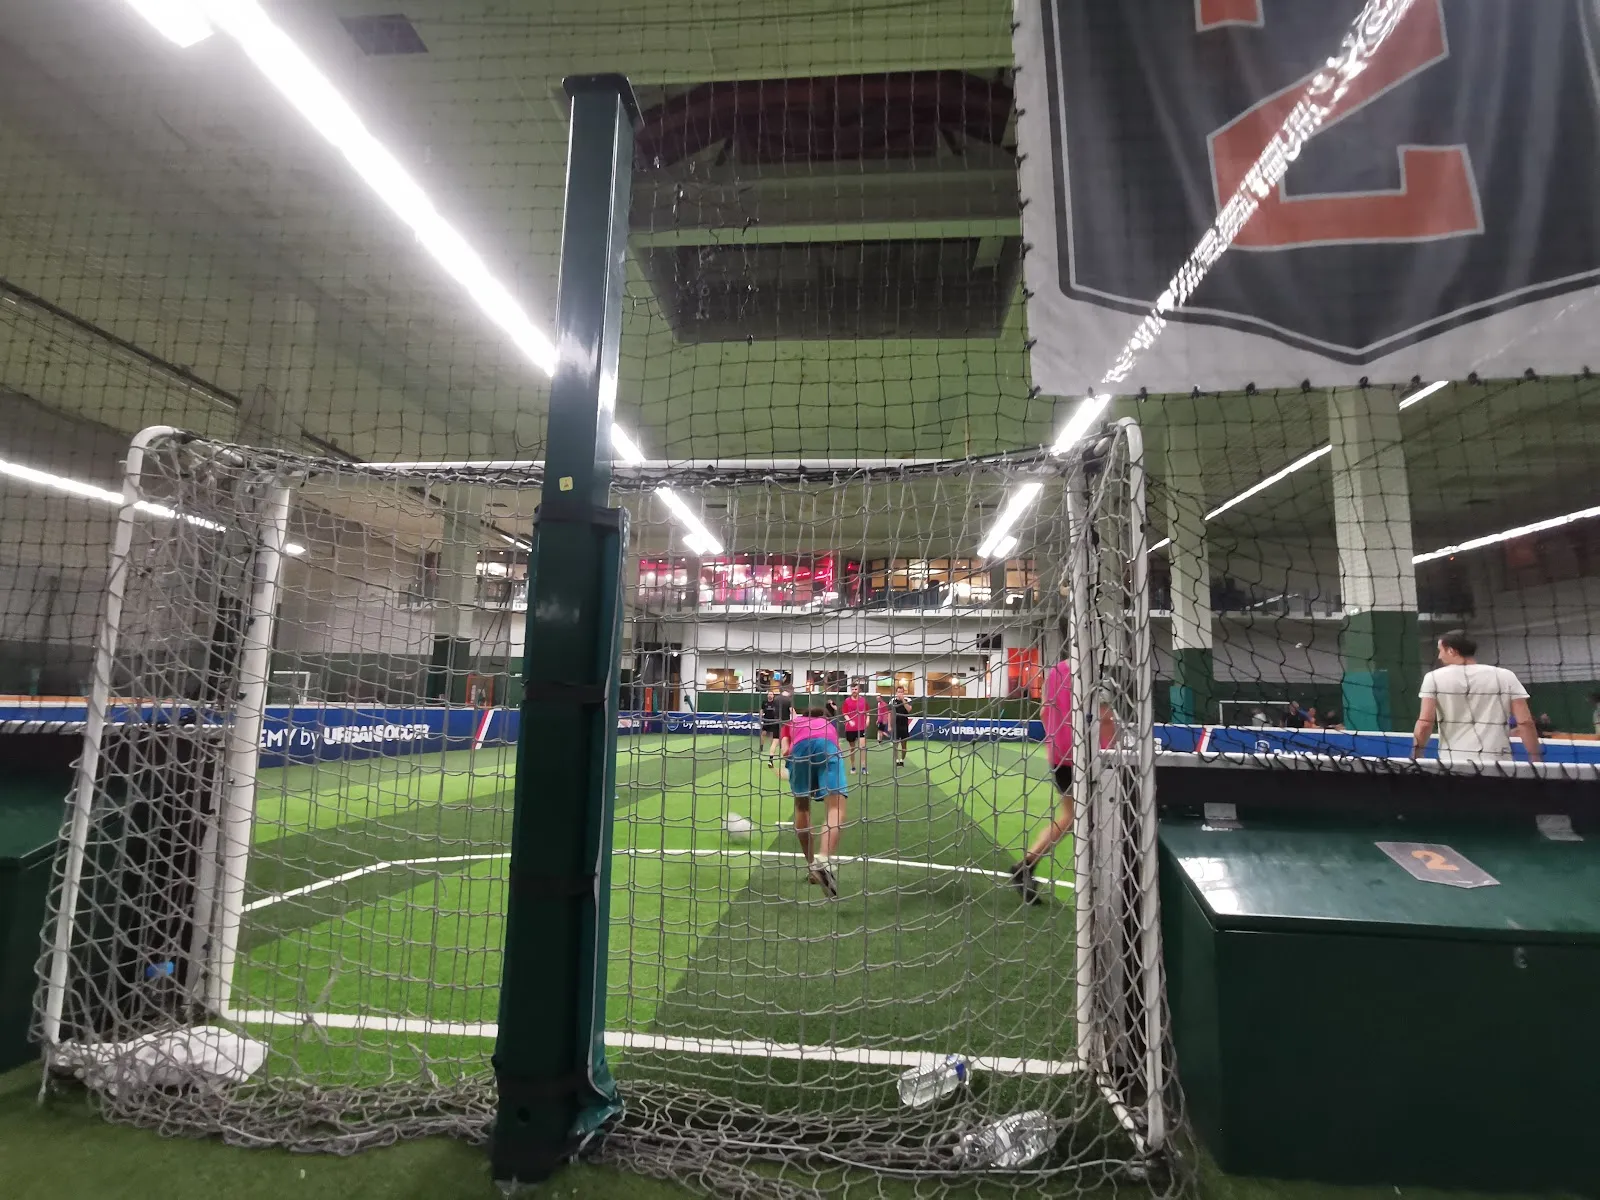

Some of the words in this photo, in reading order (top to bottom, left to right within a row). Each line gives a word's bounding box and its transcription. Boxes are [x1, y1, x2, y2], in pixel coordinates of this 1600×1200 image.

[300, 726, 320, 750] by
[323, 723, 430, 745] URBANSOCCER
[938, 726, 950, 736] by
[1411, 849, 1460, 871] 2
